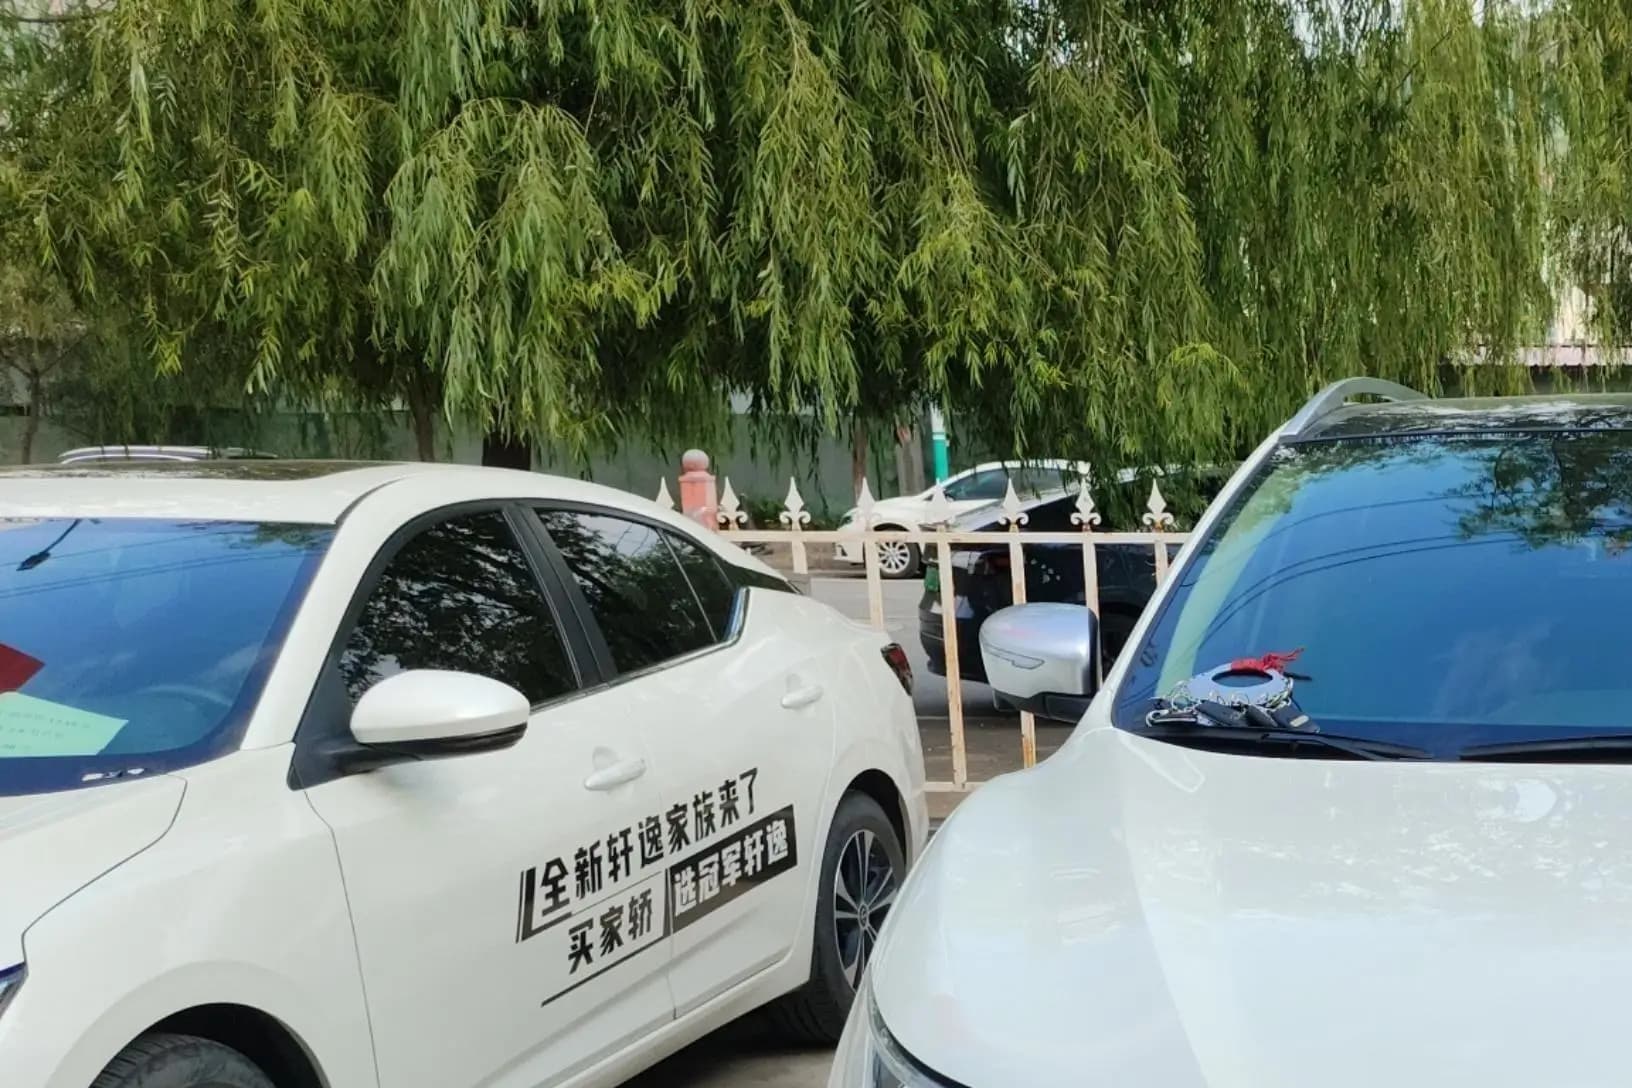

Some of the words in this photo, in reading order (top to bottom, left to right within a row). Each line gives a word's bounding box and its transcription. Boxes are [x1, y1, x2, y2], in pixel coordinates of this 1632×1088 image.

[540, 767, 758, 917] 全新轩逸家族来了
[568, 888, 652, 975] 买家轿
[674, 819, 789, 917] 选冠军轩逸
